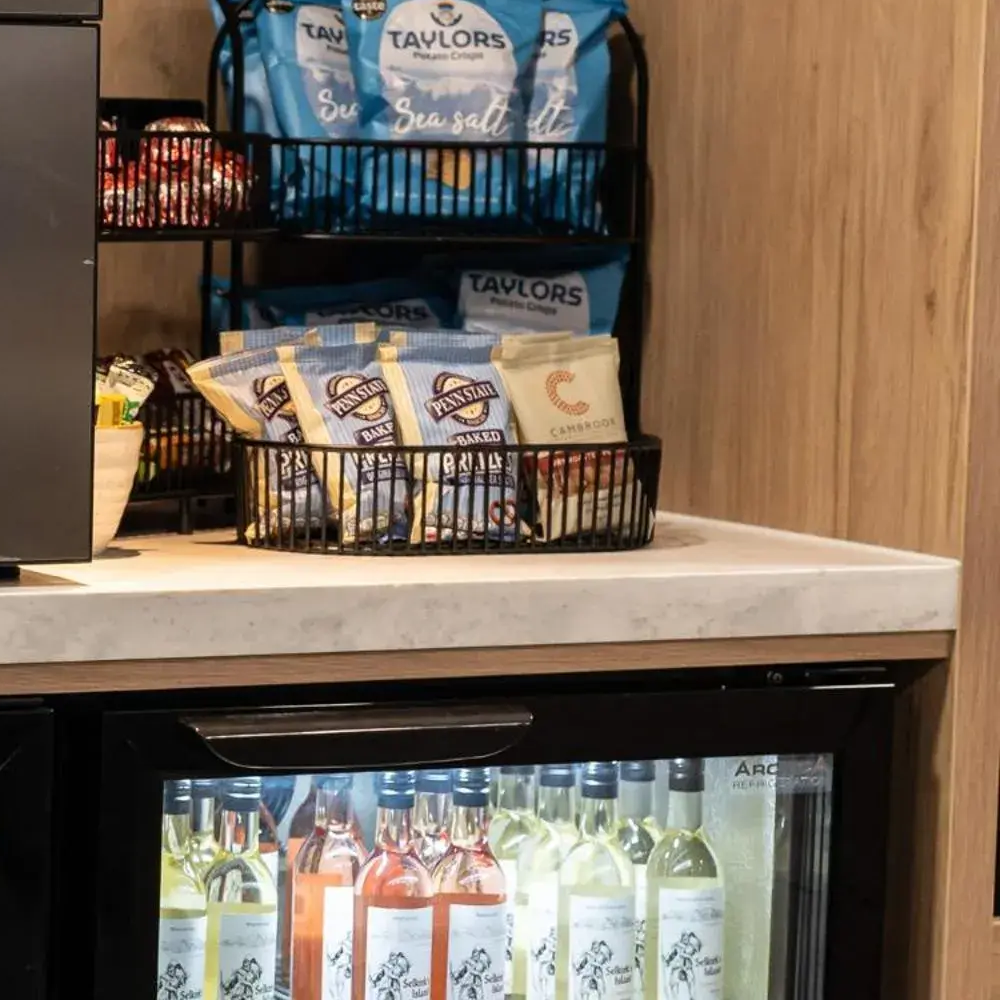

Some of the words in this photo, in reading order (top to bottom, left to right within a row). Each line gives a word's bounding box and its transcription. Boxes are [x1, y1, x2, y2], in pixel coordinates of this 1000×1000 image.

[387, 29, 506, 50] TAYLORS
[394, 97, 446, 135] Sea
[451, 94, 512, 136] salt
[469, 274, 583, 307] TAYLORS
[331, 390, 363, 415] PENN
[432, 390, 466, 416] PENN
[463, 383, 497, 400] STATE
[456, 430, 501, 446] BAKED
